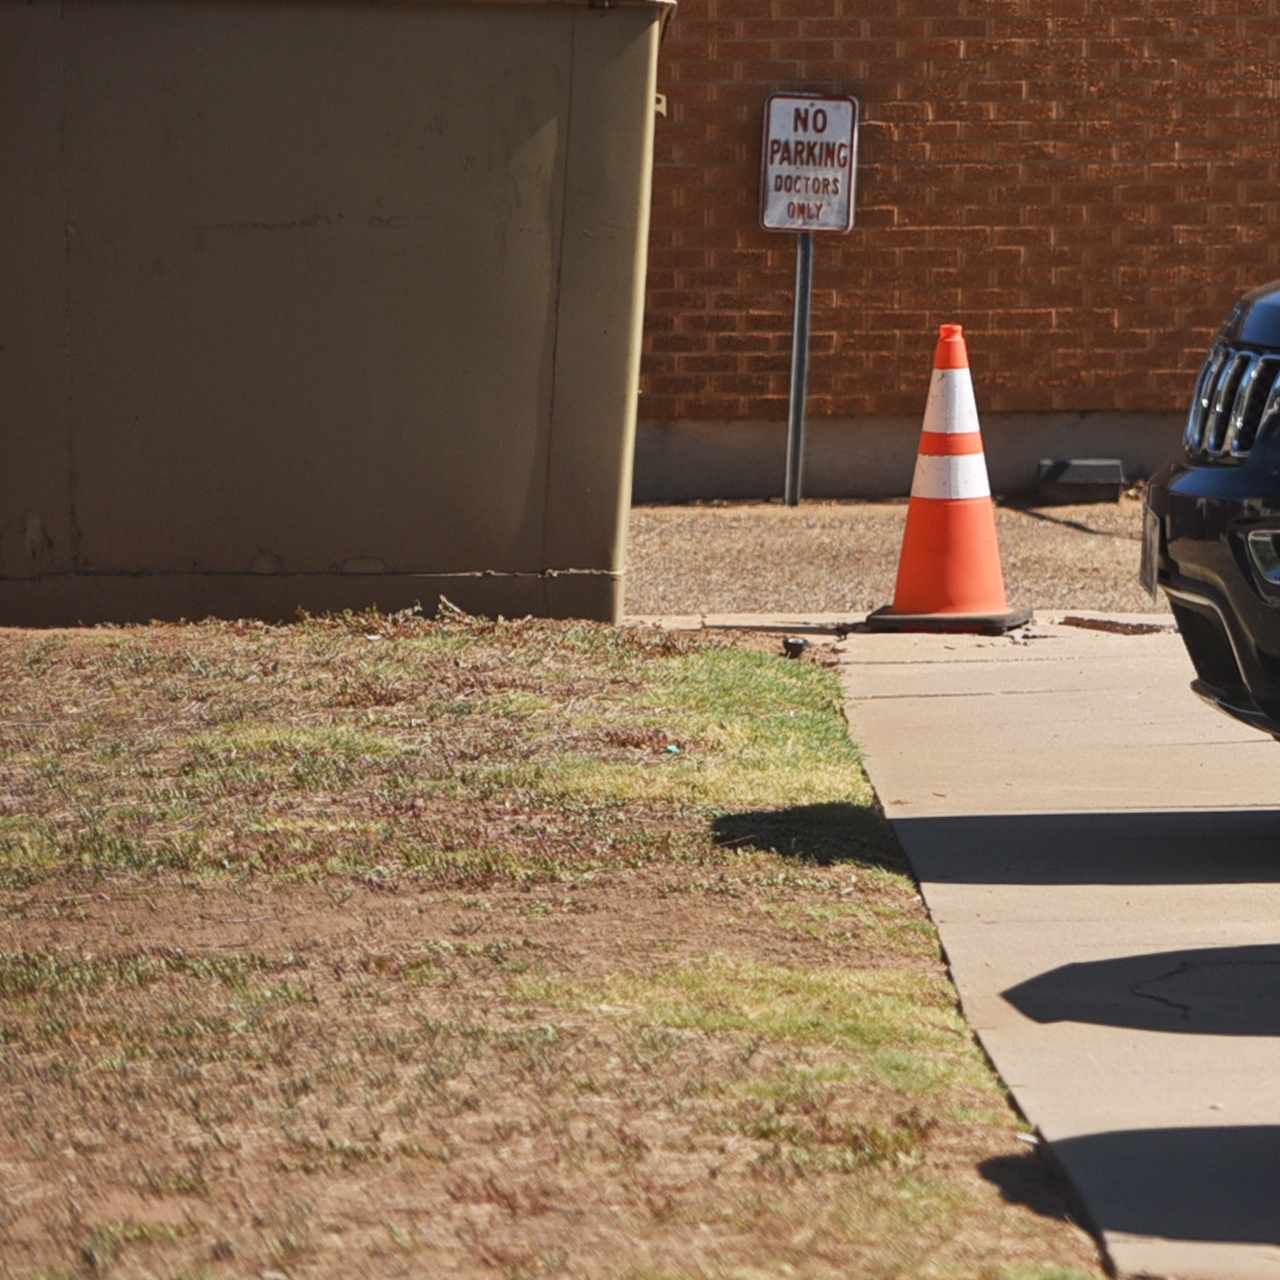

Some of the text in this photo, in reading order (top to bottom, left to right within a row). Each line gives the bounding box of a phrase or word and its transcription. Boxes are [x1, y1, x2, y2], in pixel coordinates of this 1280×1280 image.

[793, 107, 827, 134] NO
[769, 139, 848, 169] PARKING
[774, 175, 840, 195] DOCTORS
[787, 201, 824, 221] ONLY
